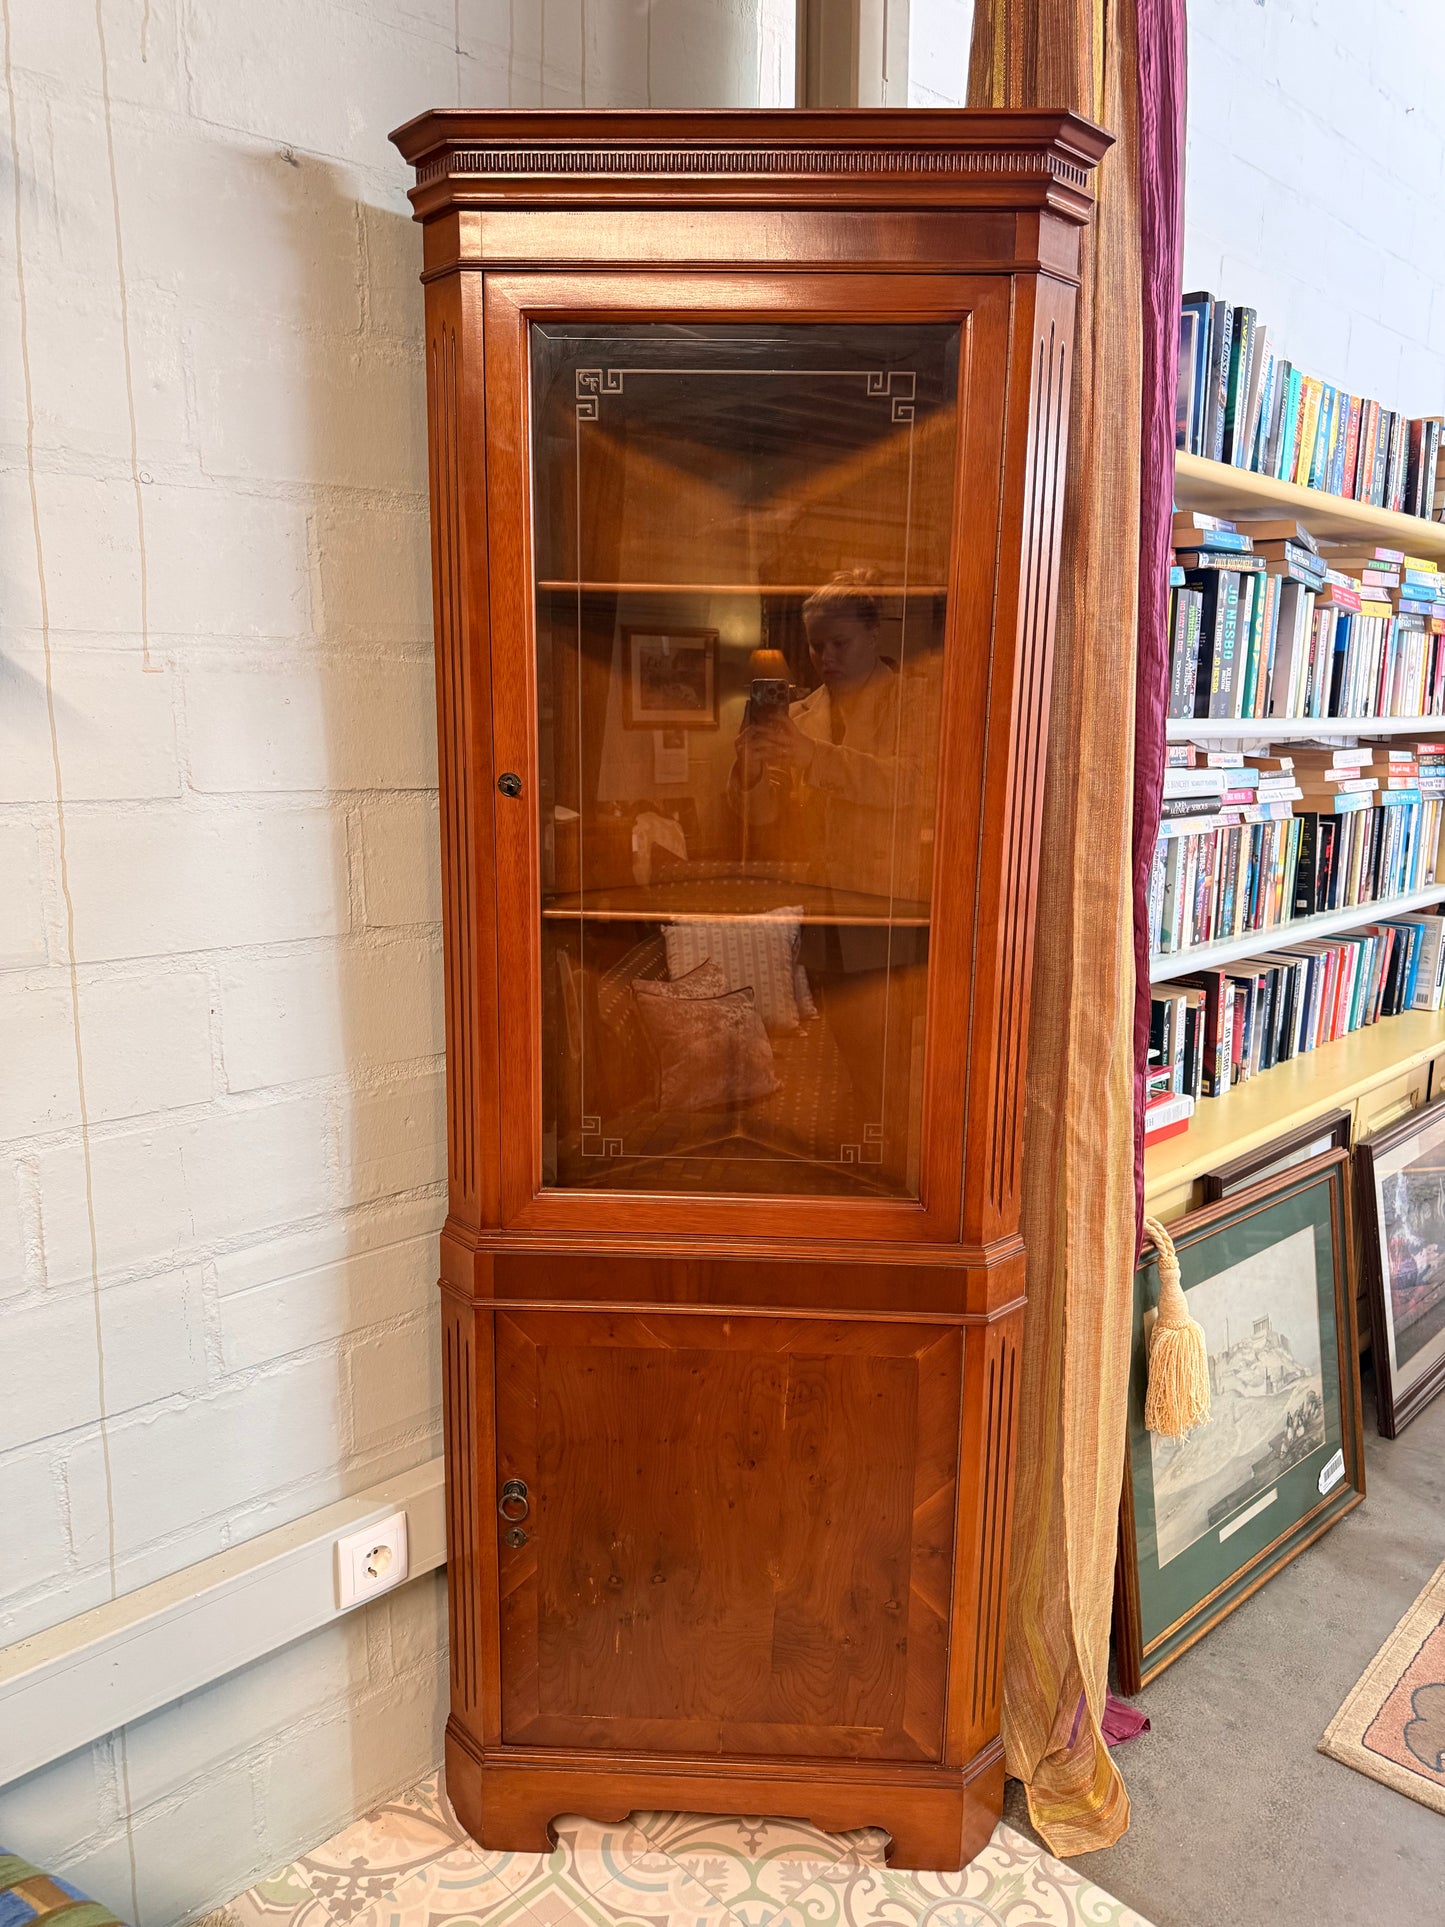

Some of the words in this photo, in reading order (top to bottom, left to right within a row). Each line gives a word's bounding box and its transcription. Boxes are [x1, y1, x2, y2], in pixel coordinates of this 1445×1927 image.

[1223, 309, 1233, 339] CLIVE
[1221, 341, 1231, 386] CUSSLER
[1282, 376, 1290, 398] John
[1278, 398, 1288, 433] Grisham
[1308, 385, 1319, 421] WILBUR
[1339, 396, 1347, 433] WILBUR
[1304, 421, 1314, 449] SMITH
[1379, 413, 1387, 449] LARSSON
[1228, 585, 1238, 604] JO
[1216, 607, 1225, 622] THE
[1178, 630, 1184, 639] TO
[1215, 624, 1223, 652] THIRST
[1223, 610, 1237, 660] NESBO
[1213, 655, 1220, 666] JO
[1225, 1026, 1231, 1038] JO
